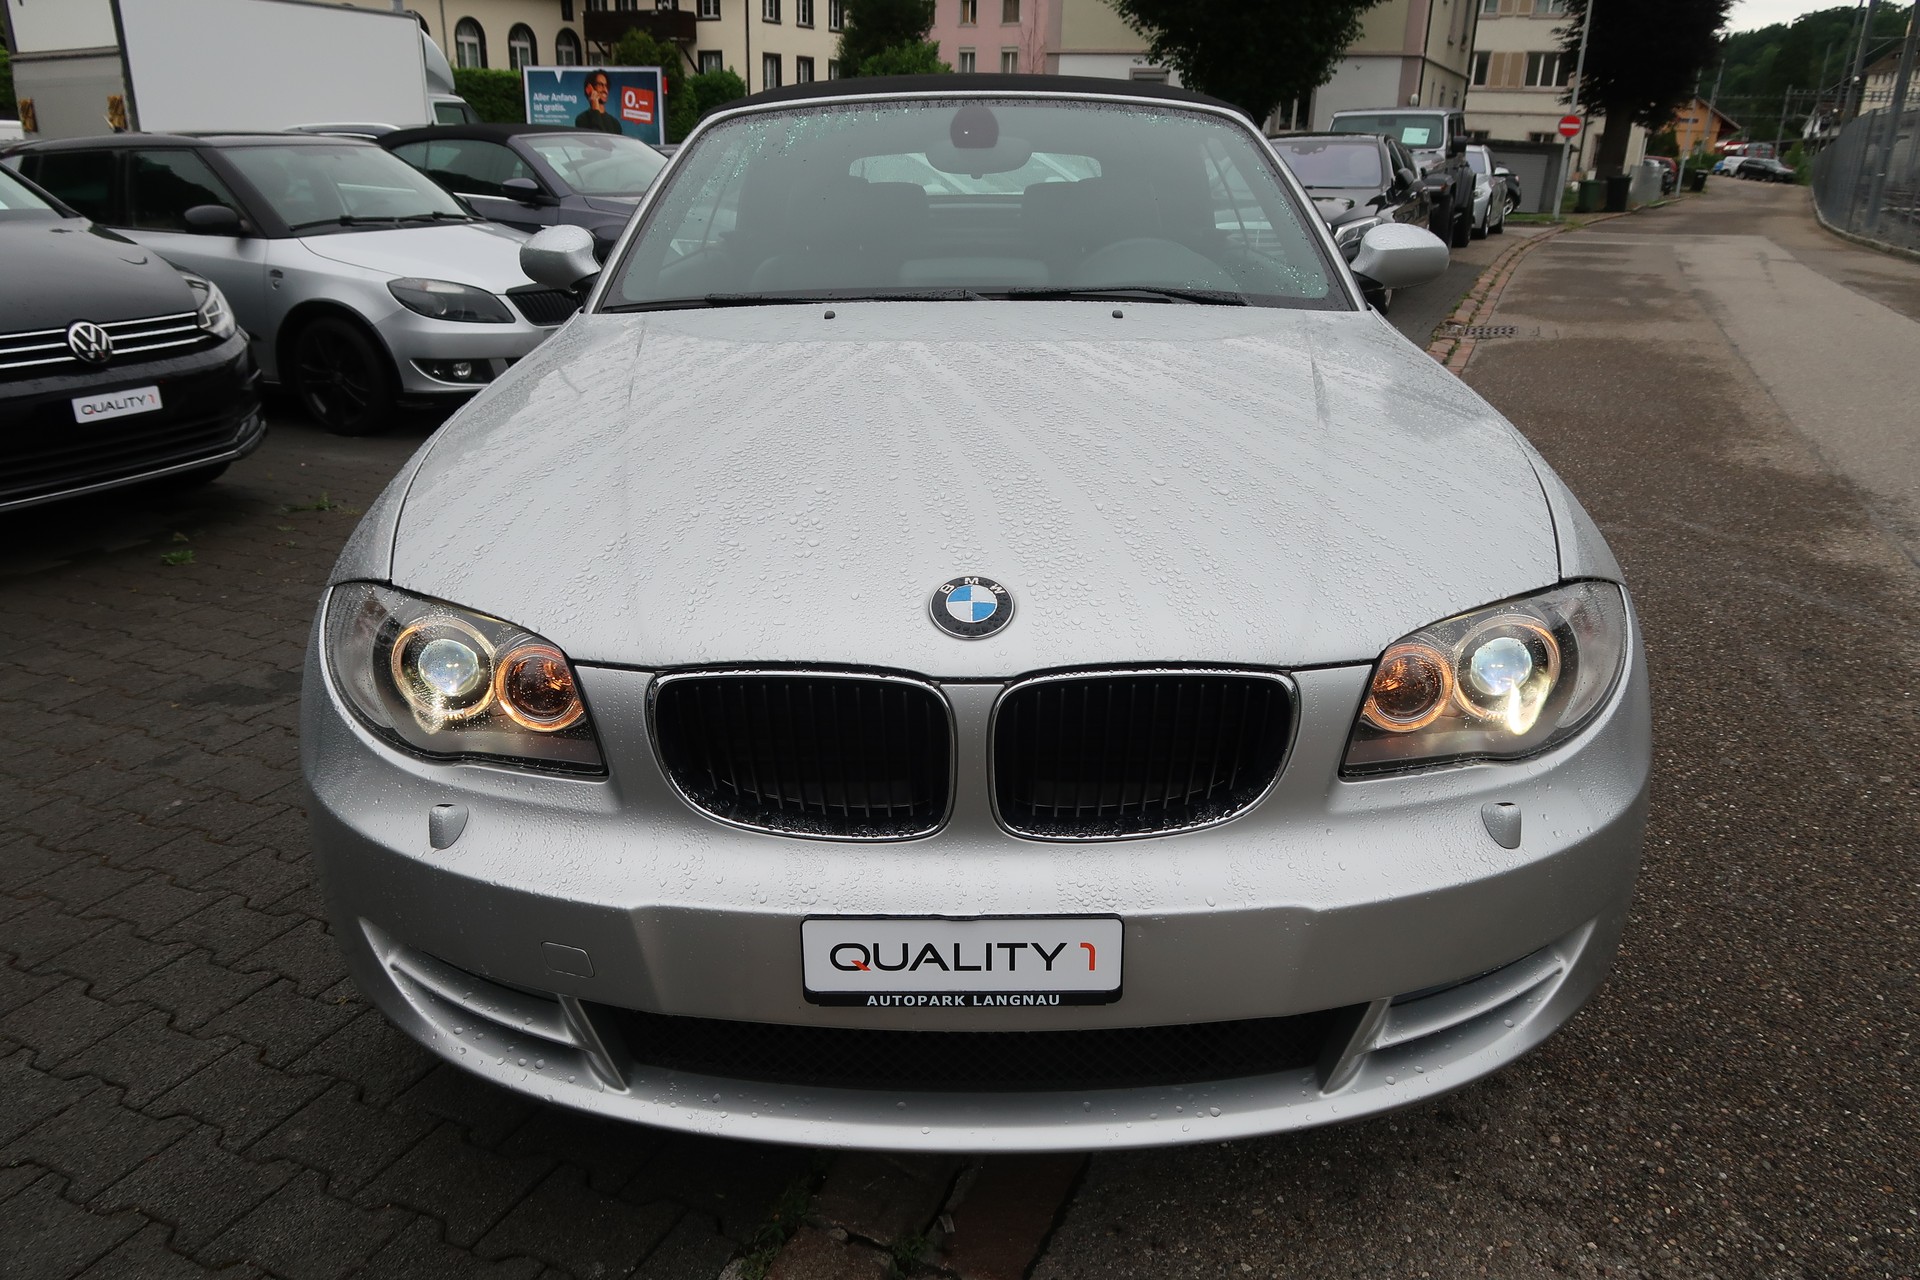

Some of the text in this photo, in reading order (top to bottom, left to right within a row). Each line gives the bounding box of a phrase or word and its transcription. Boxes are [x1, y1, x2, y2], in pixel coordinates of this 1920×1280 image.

[533, 92, 577, 104] Aller Anfang
[533, 102, 543, 111] ist
[81, 395, 146, 415] QUALITY
[939, 577, 1006, 595] BMW
[829, 942, 1068, 972] QUALITY
[867, 994, 1061, 1007] AUTOPARK LANGNAU
